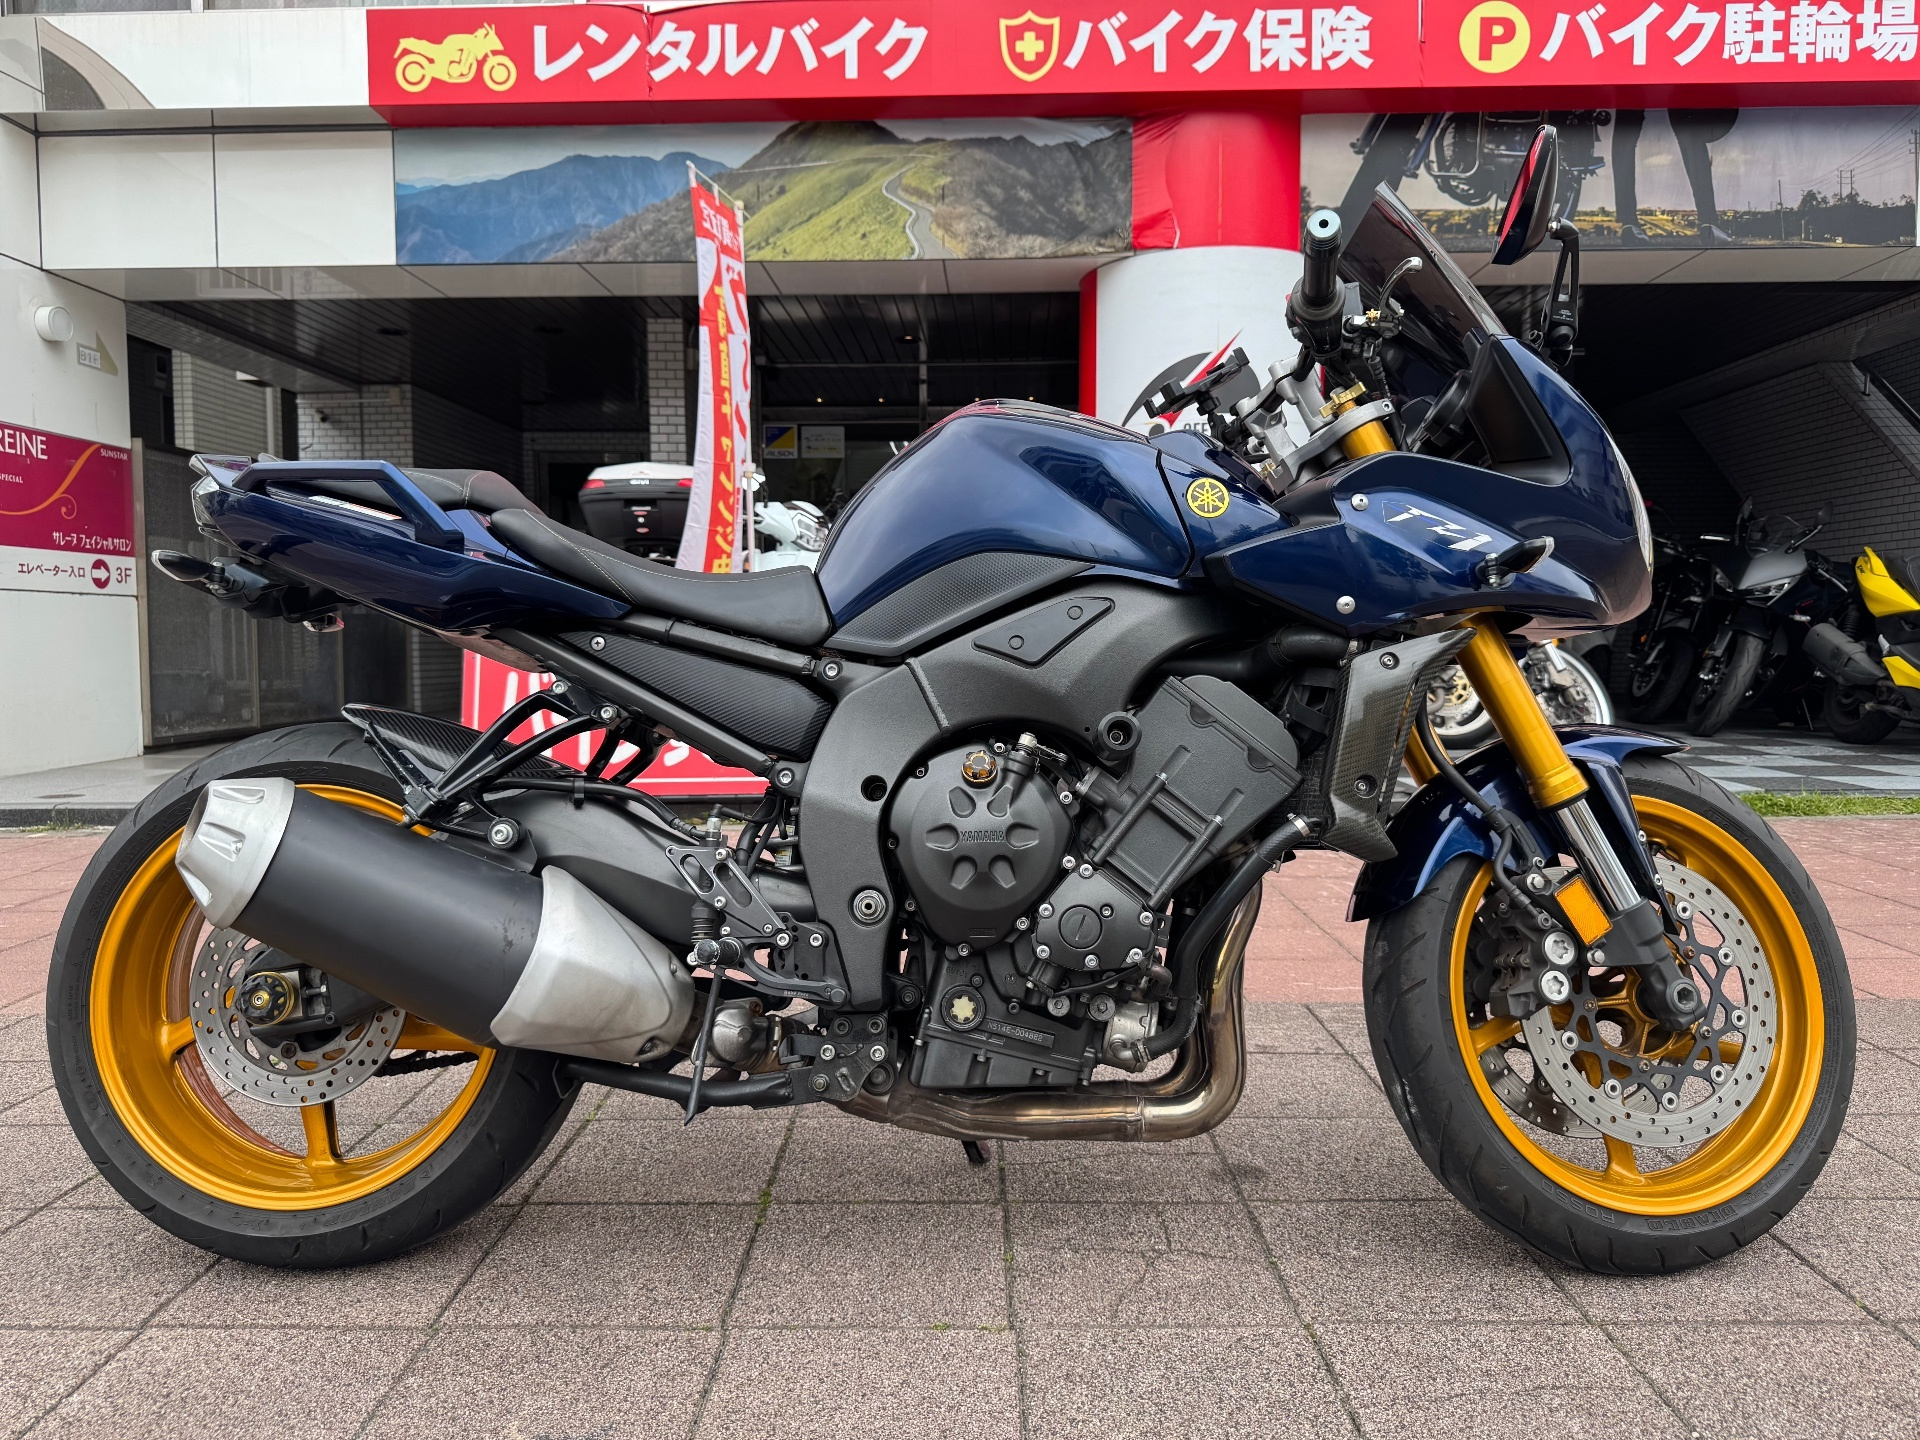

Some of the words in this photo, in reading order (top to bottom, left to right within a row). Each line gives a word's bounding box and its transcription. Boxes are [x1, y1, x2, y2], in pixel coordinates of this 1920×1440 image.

[1063, 5, 1374, 74] バイク保険
[1539, 0, 1919, 66] バイク駐輪場
[532, 16, 929, 82] レンタルバイク
[80, 349, 99, 366] B1F
[100, 448, 128, 461] SUNSTAR
[53, 531, 77, 546] サレーヌ
[80, 535, 132, 552] フェイシャルサロン
[18, 563, 85, 578] エレベーター入口
[116, 567, 132, 583] 3F
[959, 830, 1005, 843] YAMAHA
[1540, 1179, 1616, 1225] ROSSO
[1645, 1204, 1738, 1232] DIABLO
